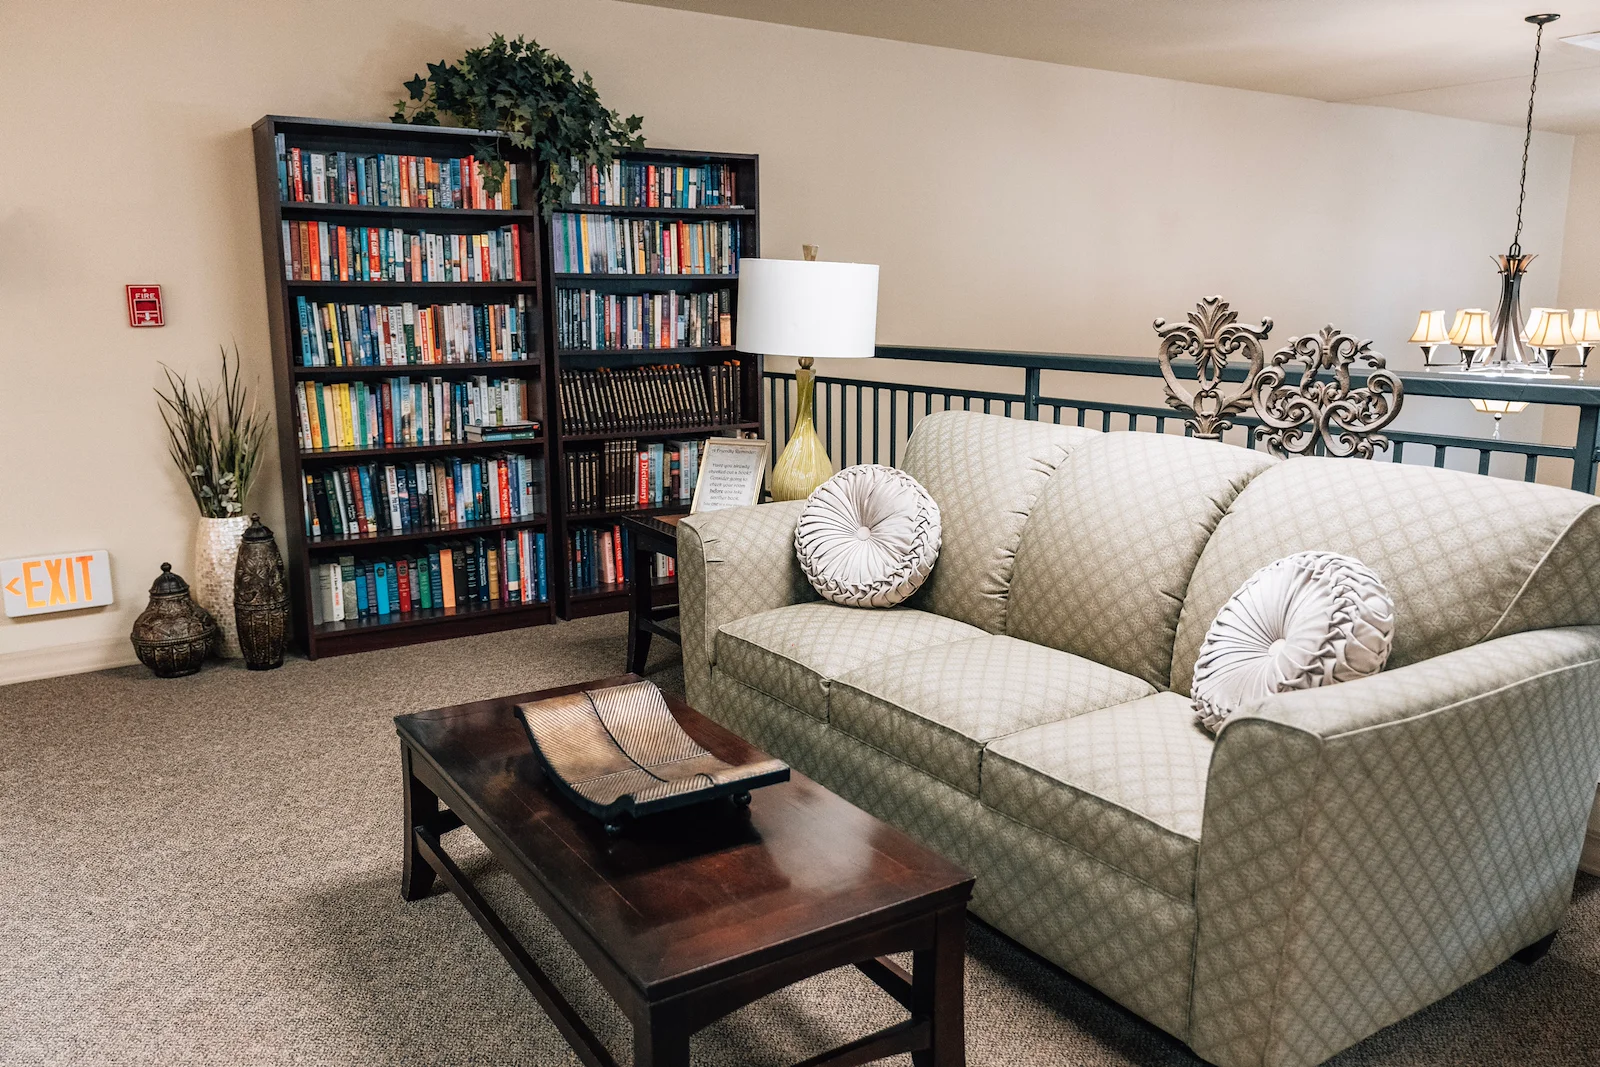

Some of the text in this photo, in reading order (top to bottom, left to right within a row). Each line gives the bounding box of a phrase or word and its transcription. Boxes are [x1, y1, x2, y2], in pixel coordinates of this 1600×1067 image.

[371, 241, 379, 256] CLANCY
[640, 462, 648, 500] Dictionary
[22, 555, 93, 608] EXIT
